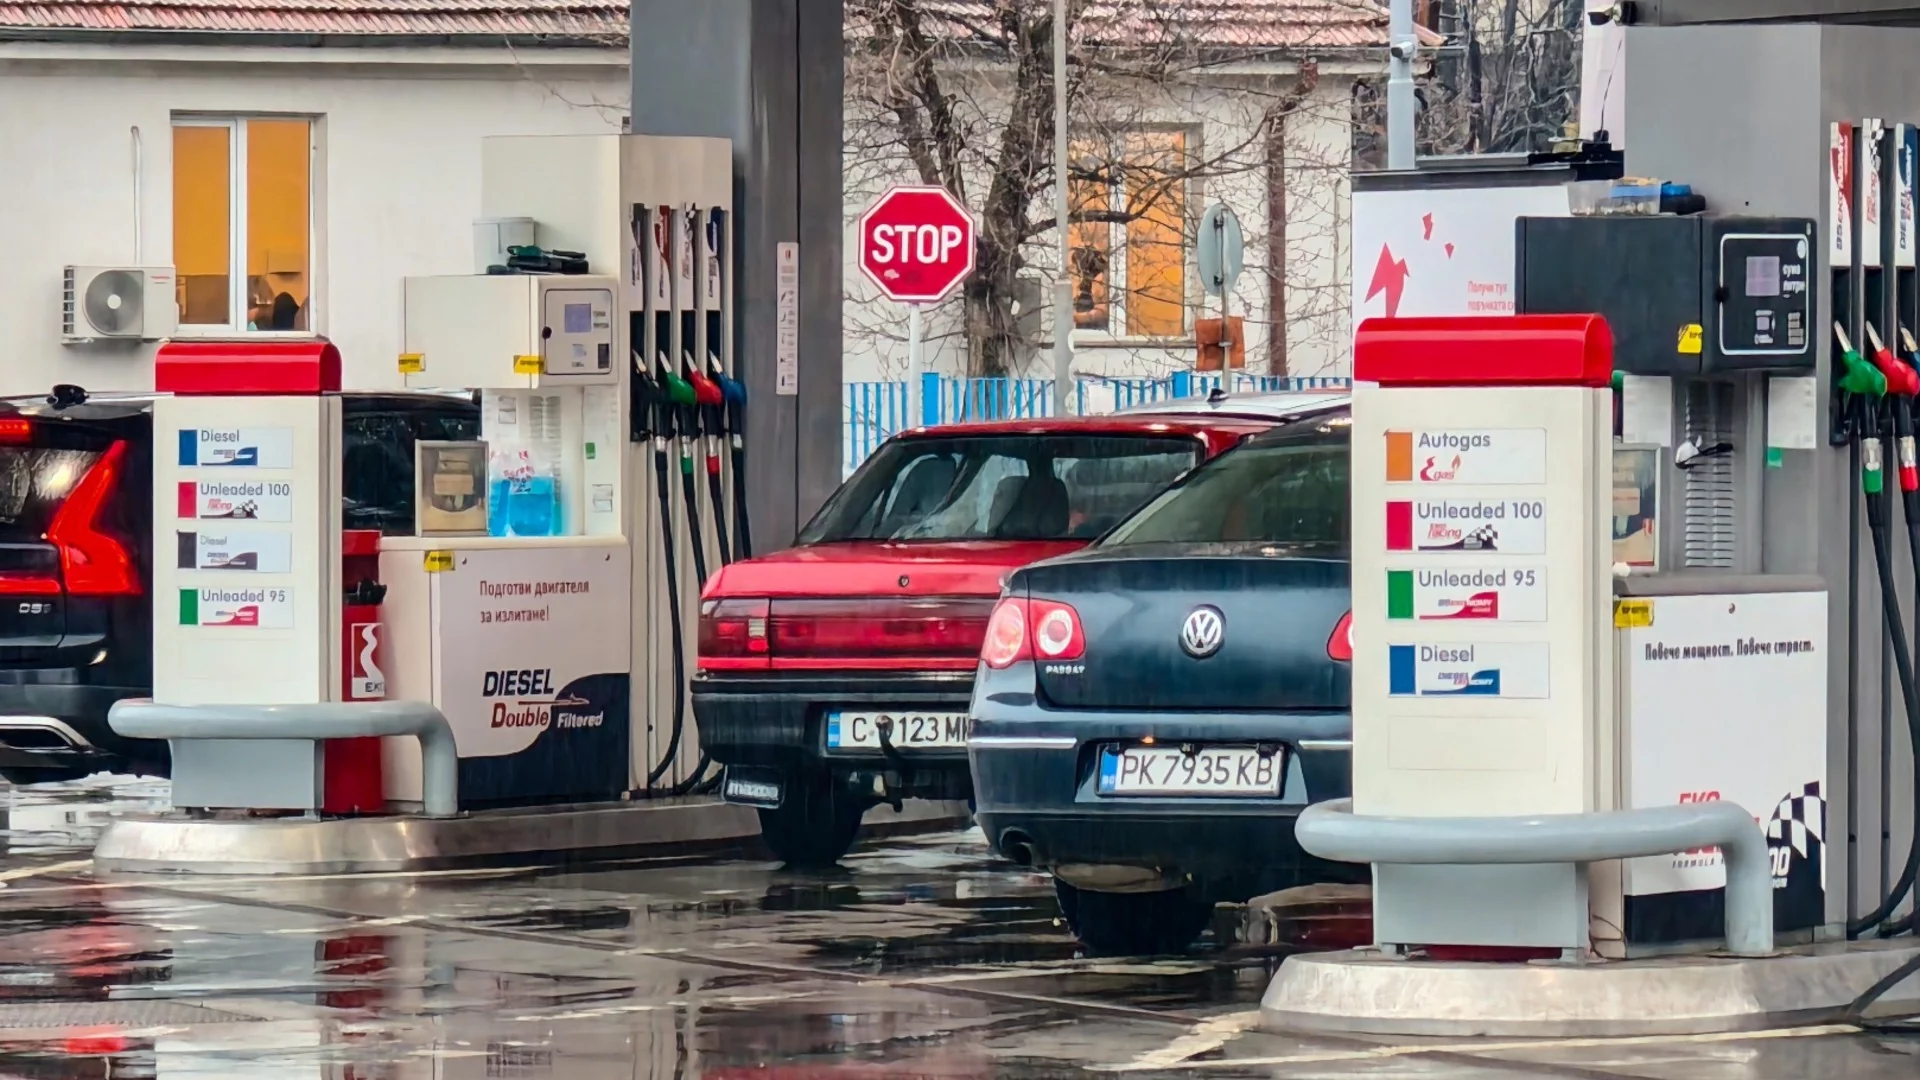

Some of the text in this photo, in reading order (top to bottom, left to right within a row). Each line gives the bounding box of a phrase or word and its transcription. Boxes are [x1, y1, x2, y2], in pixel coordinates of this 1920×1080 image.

[872, 224, 963, 264] STOP
[201, 429, 240, 442] Diesel
[1418, 432, 1491, 451] Autogas
[200, 482, 290, 496] Unleaded 100
[1418, 501, 1543, 519] Unleaded 100
[1419, 569, 1535, 587] Unleaded 95
[202, 589, 286, 602] Unleaded 95
[480, 580, 589, 598] Подготви двигателя
[480, 604, 549, 623] за излитане!
[1421, 644, 1474, 662] Diesel
[1645, 637, 1815, 661] Повече мощност. Повече страст.
[482, 668, 554, 697] DIESEL
[491, 702, 604, 729] Double Filtered
[852, 717, 867, 742] C
[1120, 755, 1273, 786] PK 7935 KB
